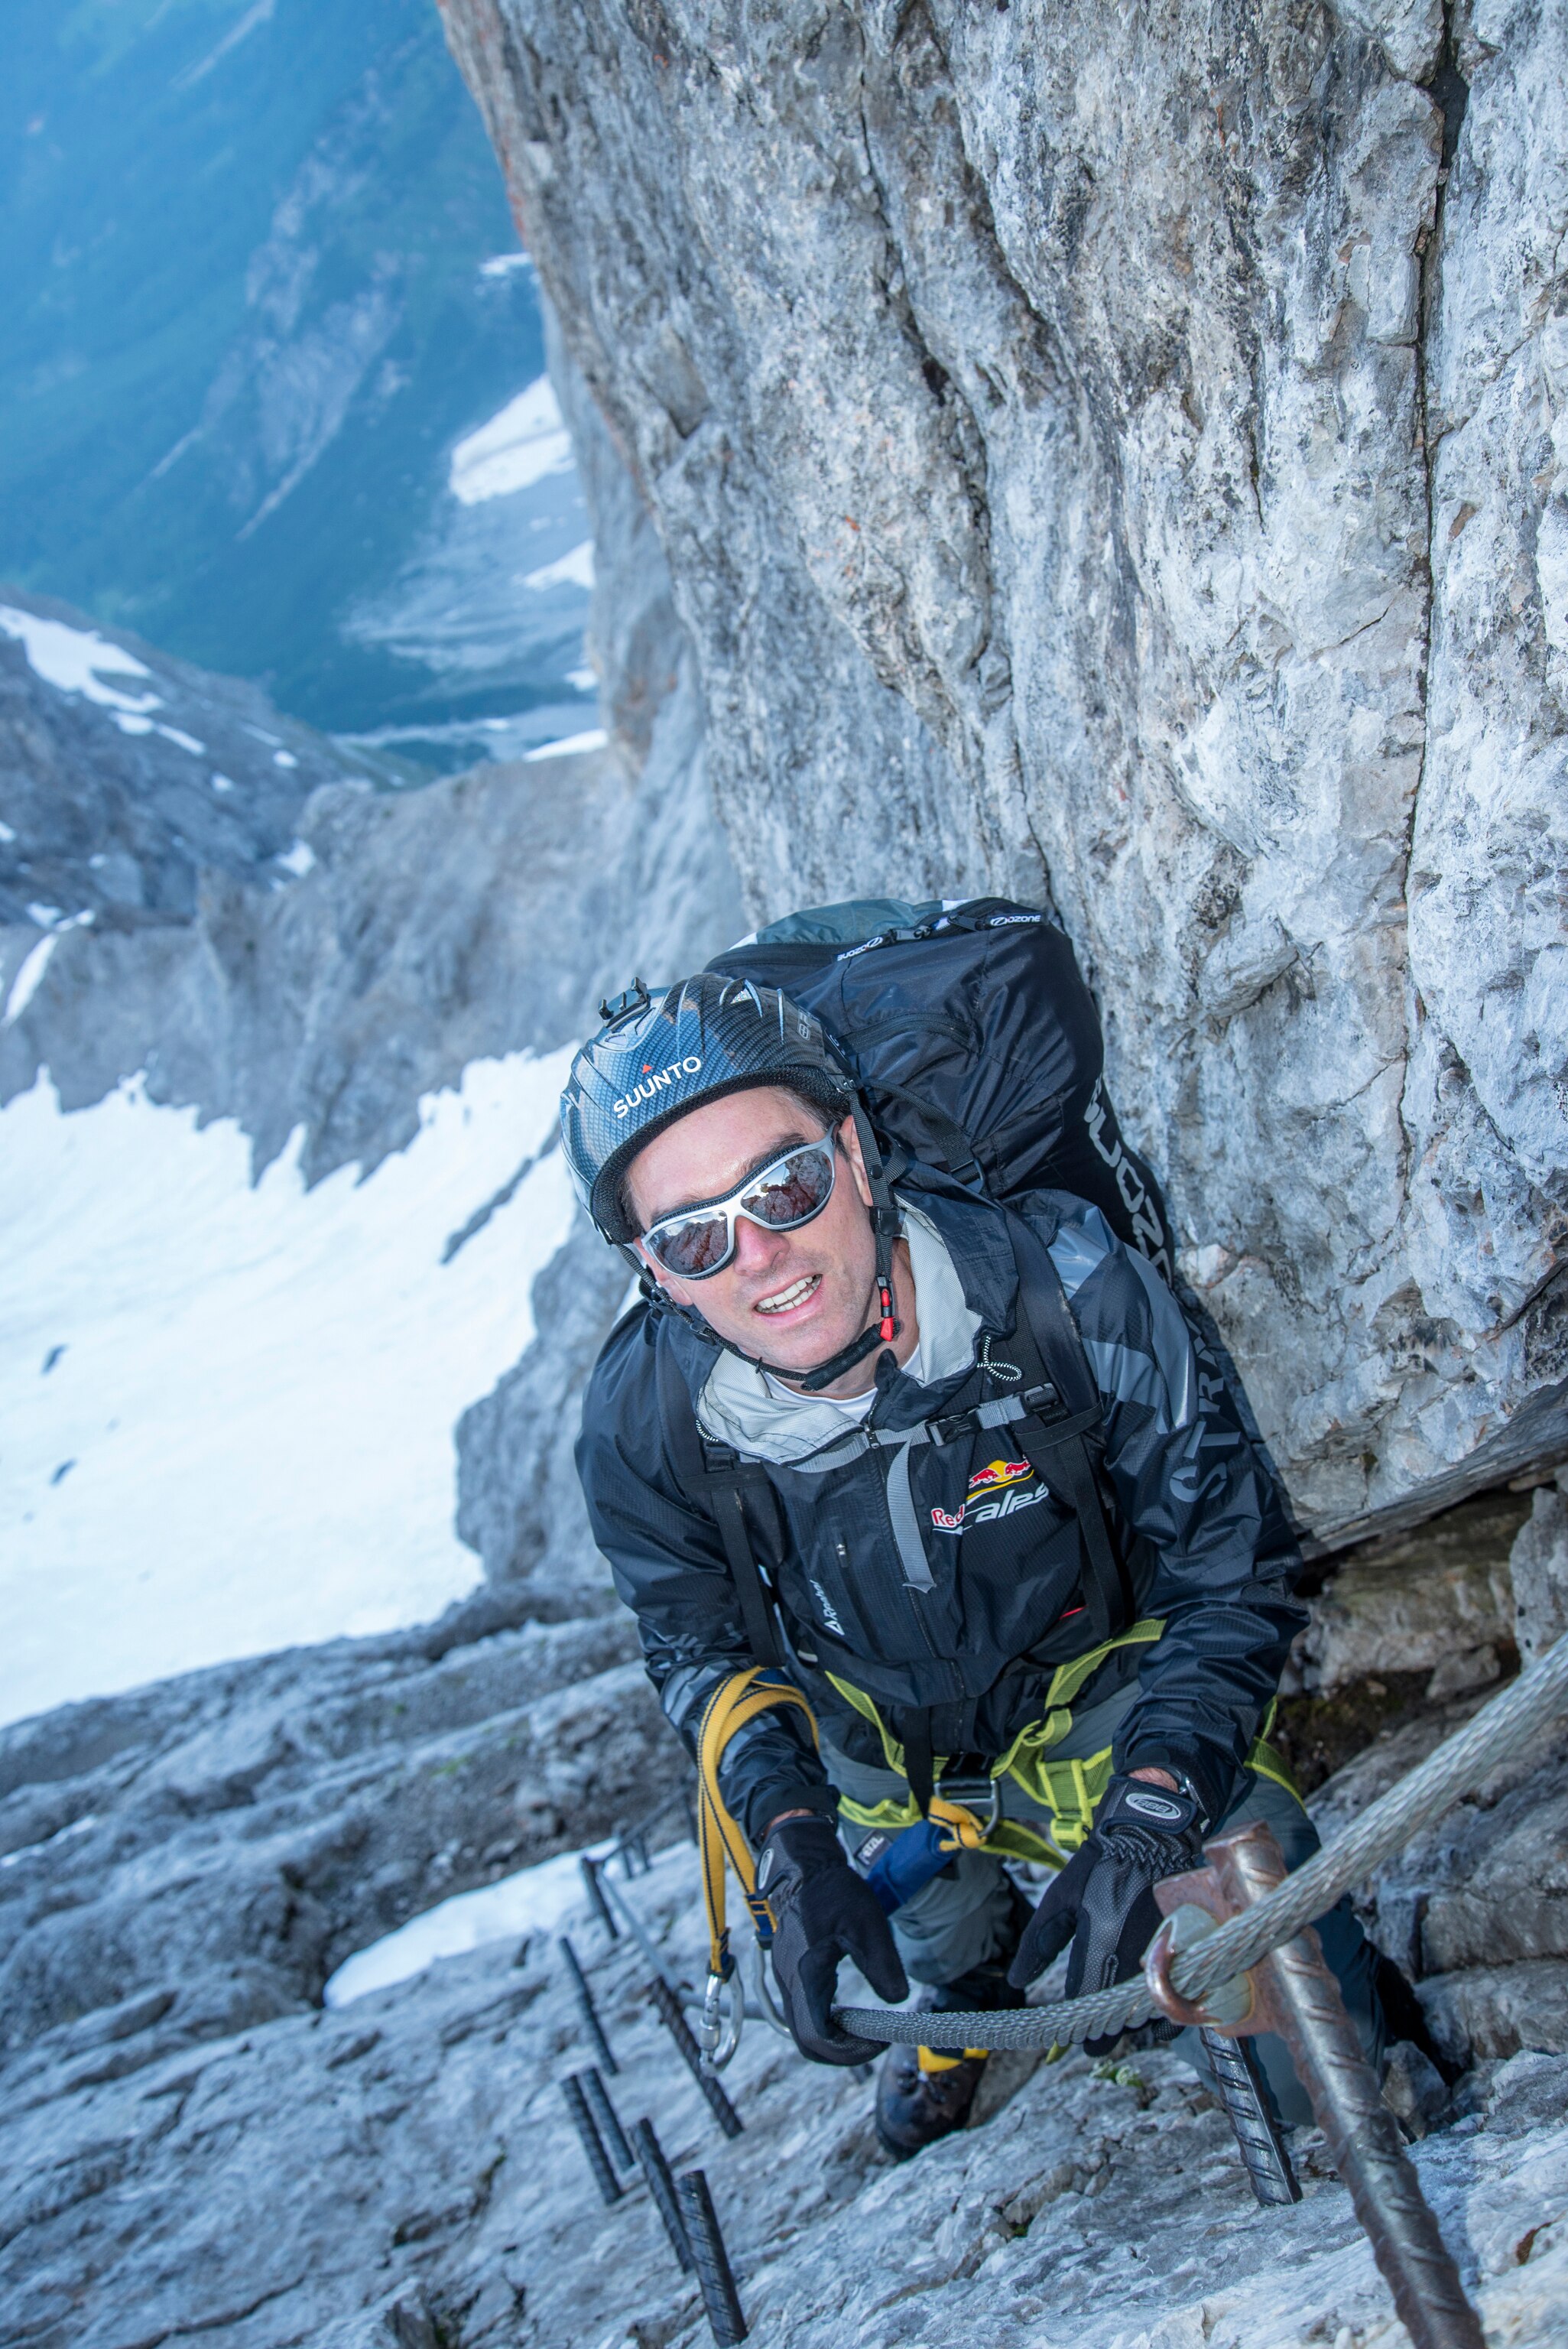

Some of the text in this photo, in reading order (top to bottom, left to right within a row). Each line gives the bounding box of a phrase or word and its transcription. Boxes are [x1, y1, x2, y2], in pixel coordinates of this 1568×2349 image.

[1007, 915, 1041, 924] OZONE
[613, 1056, 702, 1119] SUUNTO
[930, 1503, 966, 1529] Red
[1134, 1798, 1171, 1814] BBB
